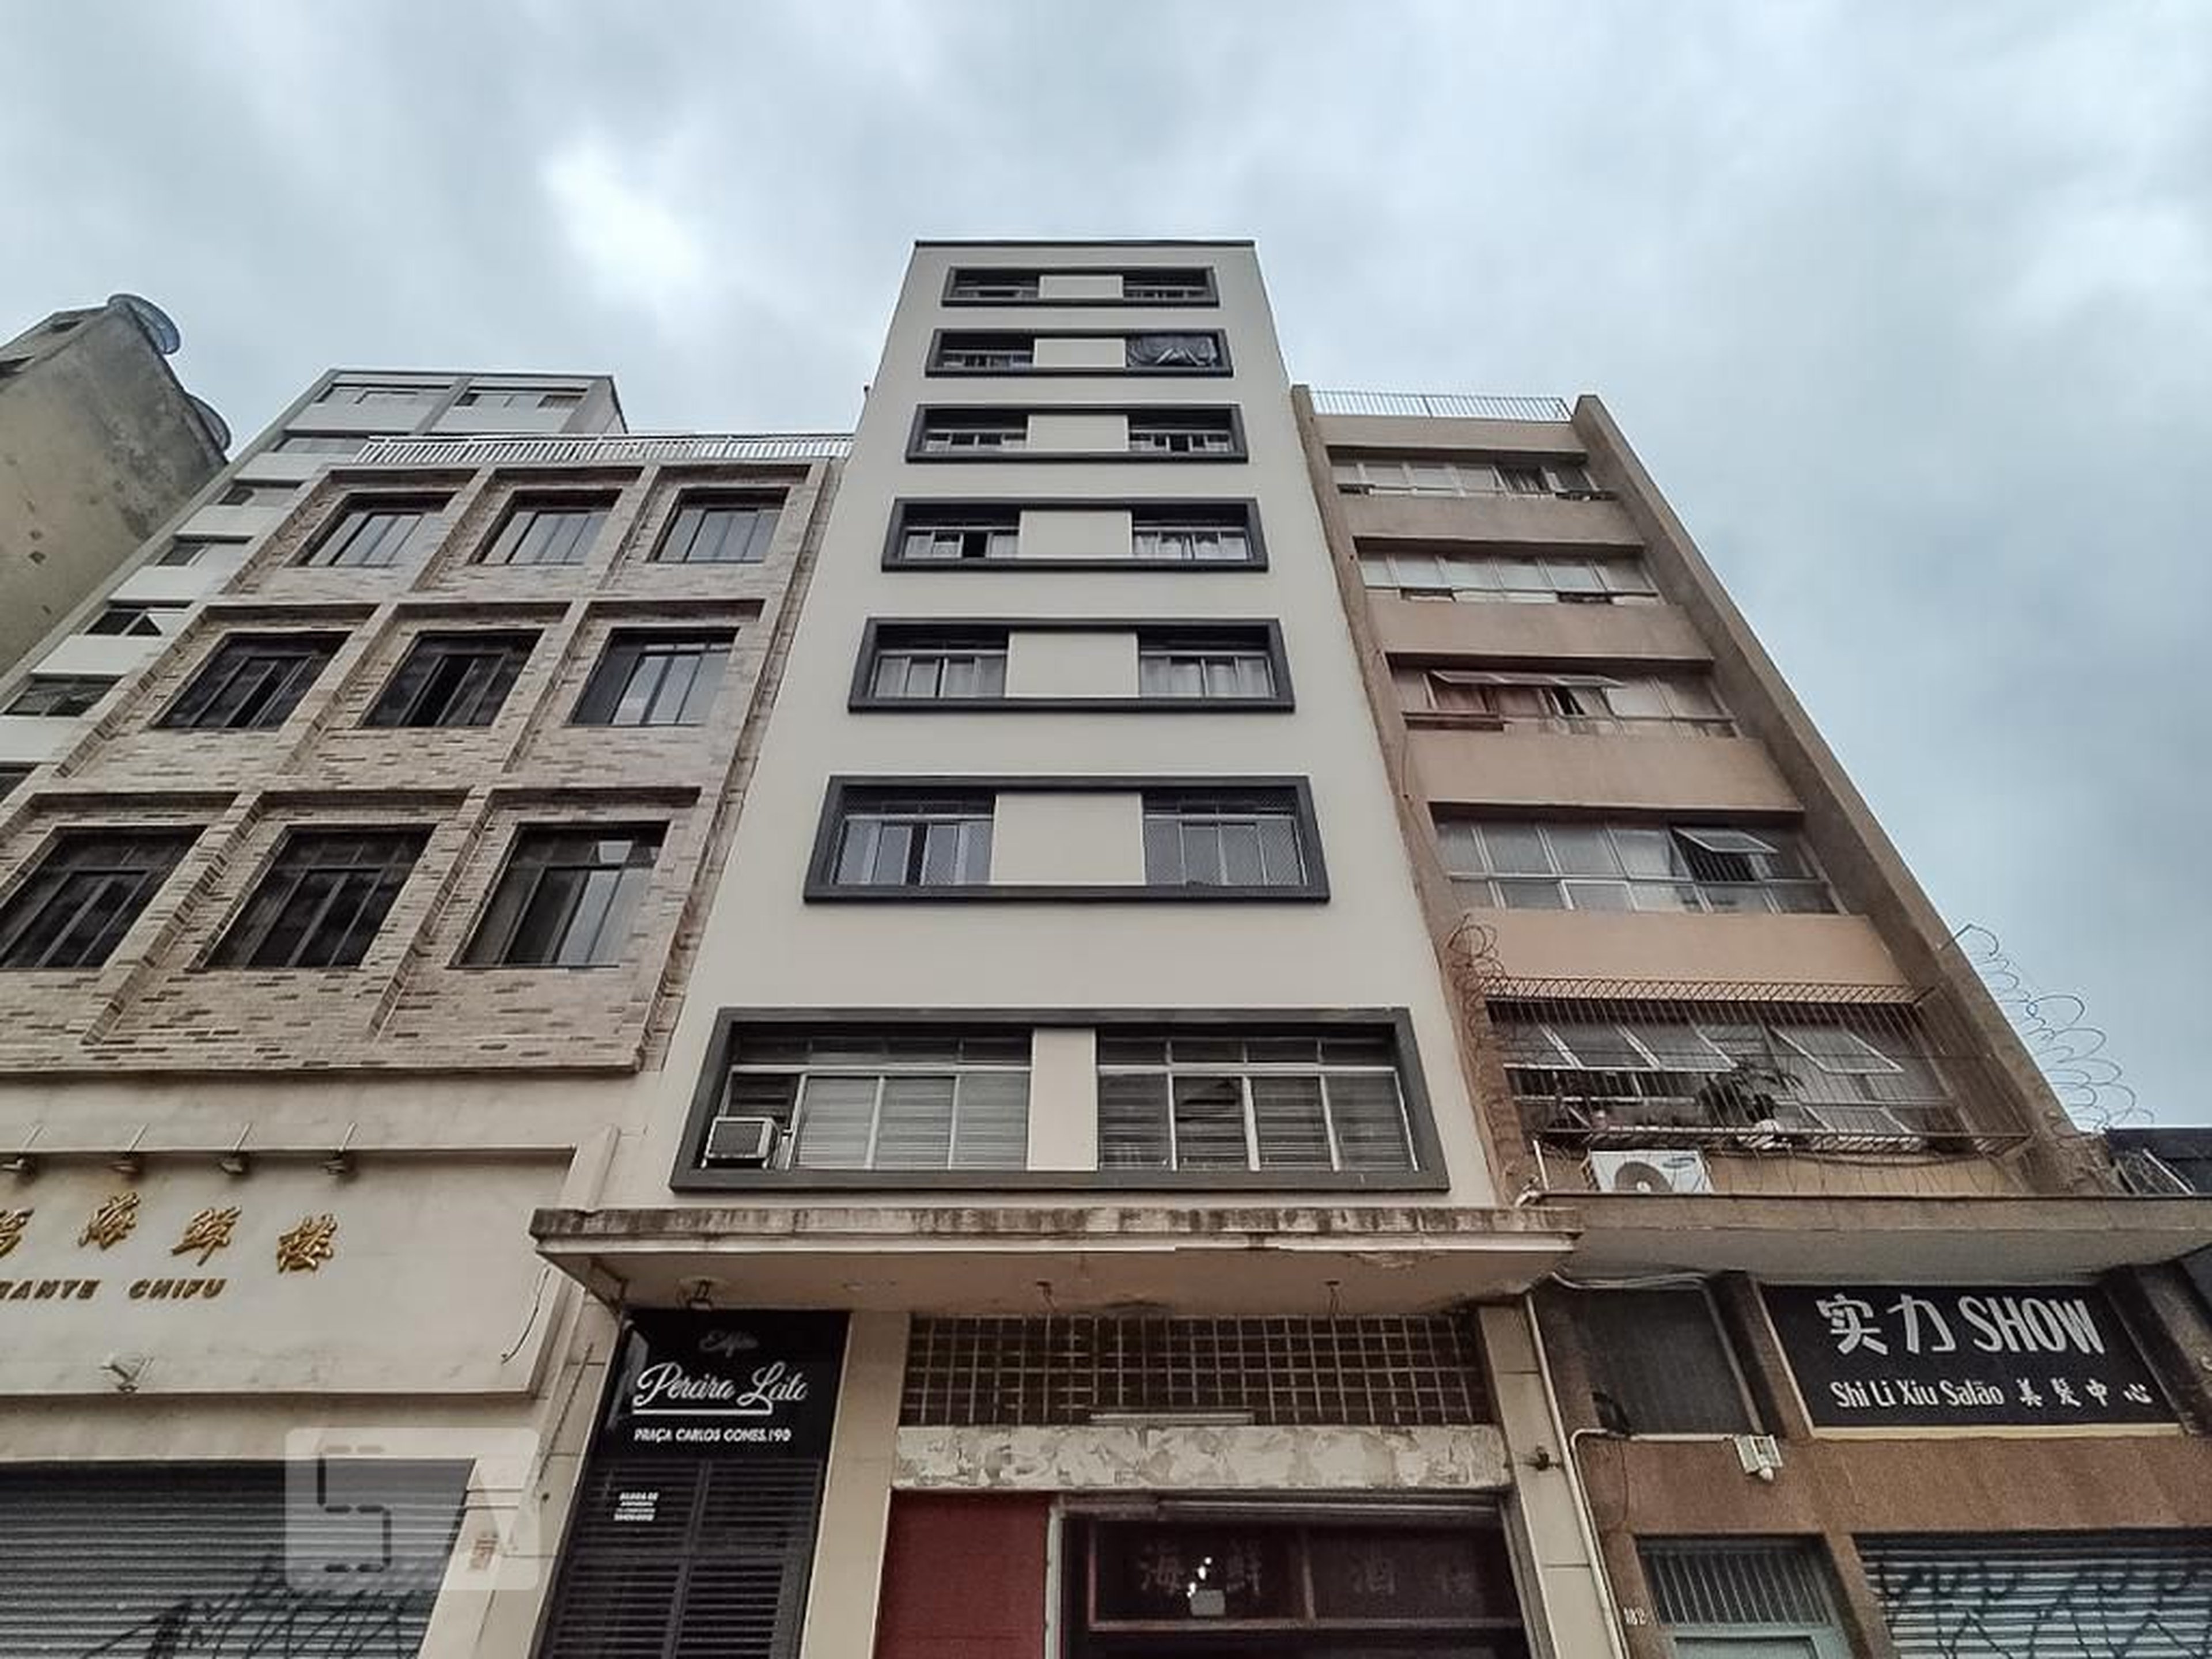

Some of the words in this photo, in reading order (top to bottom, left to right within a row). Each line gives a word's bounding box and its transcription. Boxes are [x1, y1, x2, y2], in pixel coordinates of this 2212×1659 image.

[129, 1279, 227, 1300] CHIFU
[1816, 1293, 1956, 1355] 实力
[1959, 1296, 2105, 1354] SHOW
[632, 1362, 736, 1406] Pereira
[1830, 1380, 1871, 1407] Shi
[1870, 1381, 1897, 1406] Li
[1896, 1379, 1940, 1406] Xiu
[1940, 1379, 2006, 1406] Salão
[634, 1427, 673, 1444] PRAÇA
[676, 1427, 721, 1442] CARLOS
